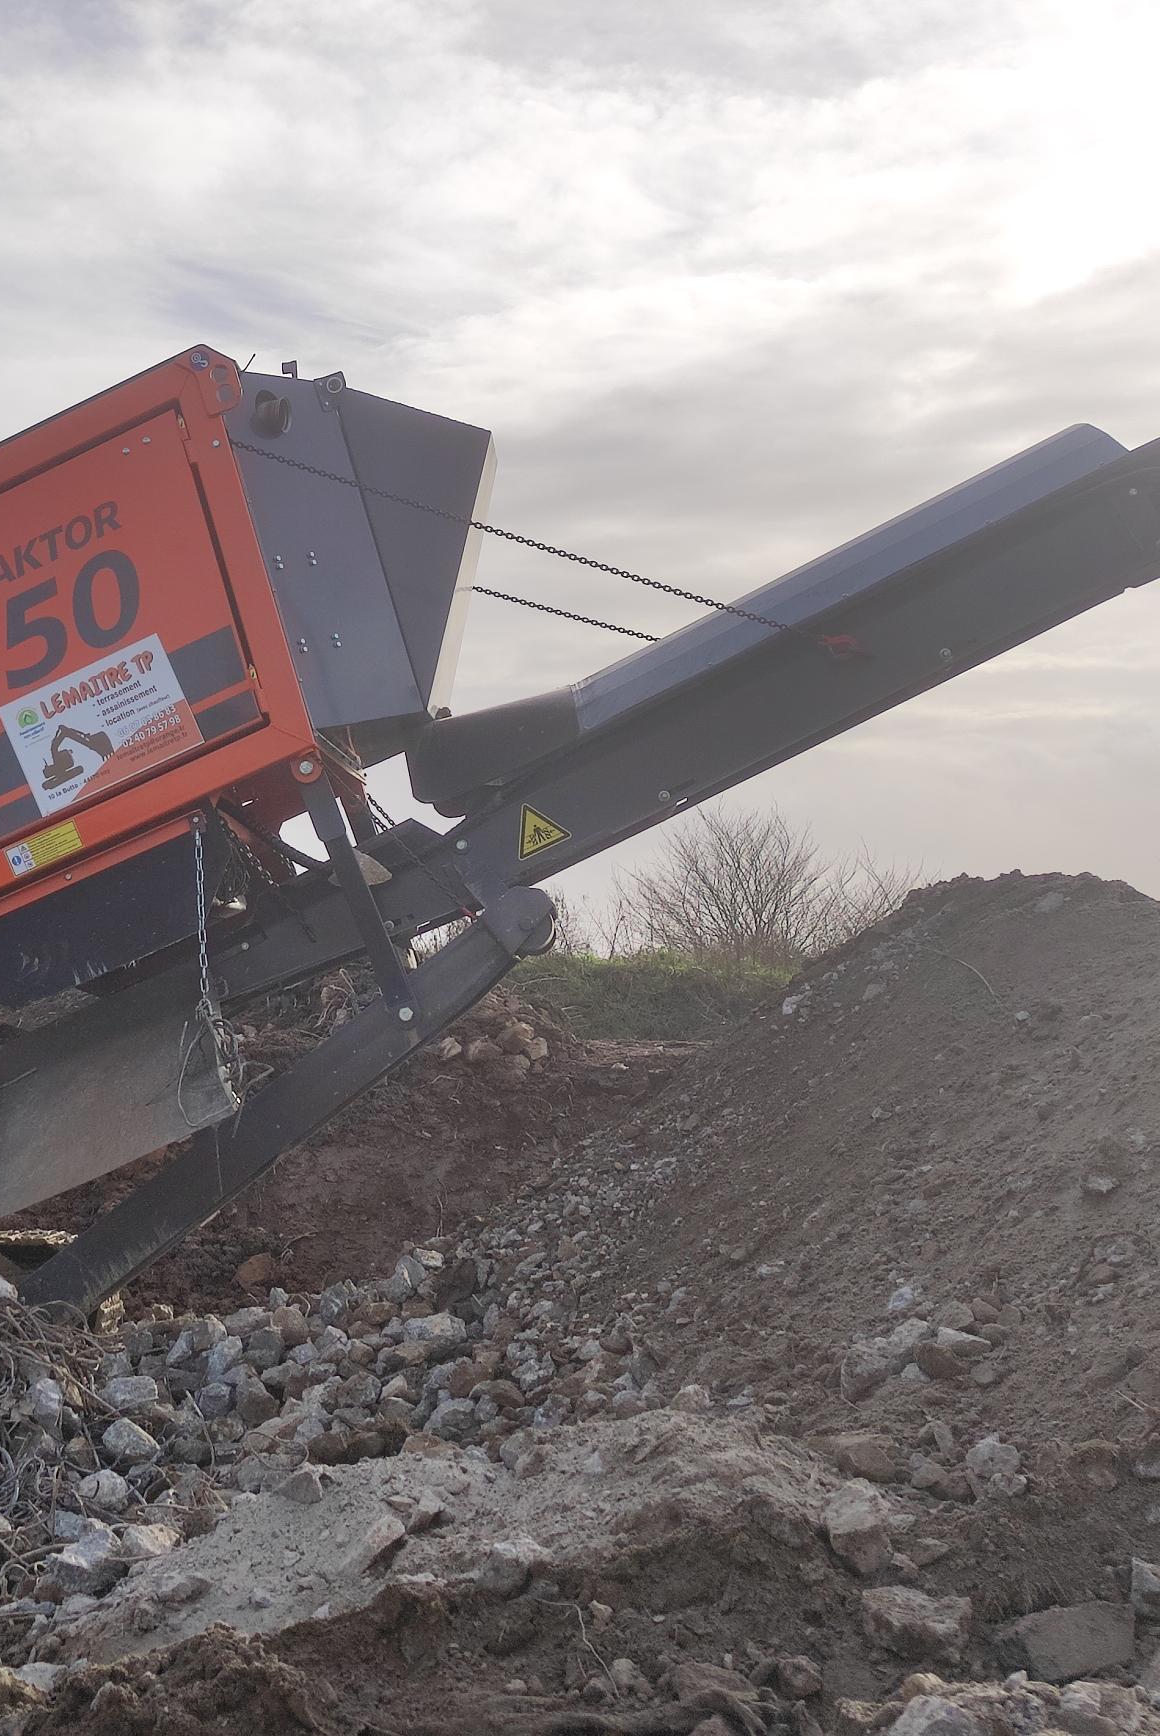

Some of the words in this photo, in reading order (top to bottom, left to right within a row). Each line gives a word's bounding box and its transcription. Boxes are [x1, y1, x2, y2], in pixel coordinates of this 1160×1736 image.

[40, 661, 133, 719] LEMAITRE
[131, 650, 154, 675] TP
[96, 680, 142, 706] terrasement
[101, 685, 158, 717] assainissement
[164, 704, 176, 716] 83
[105, 709, 136, 727] location
[122, 738, 134, 748] 02
[134, 731, 146, 742] 40
[145, 726, 157, 737] 79
[157, 720, 168, 731] 57
[169, 714, 181, 726] 98
